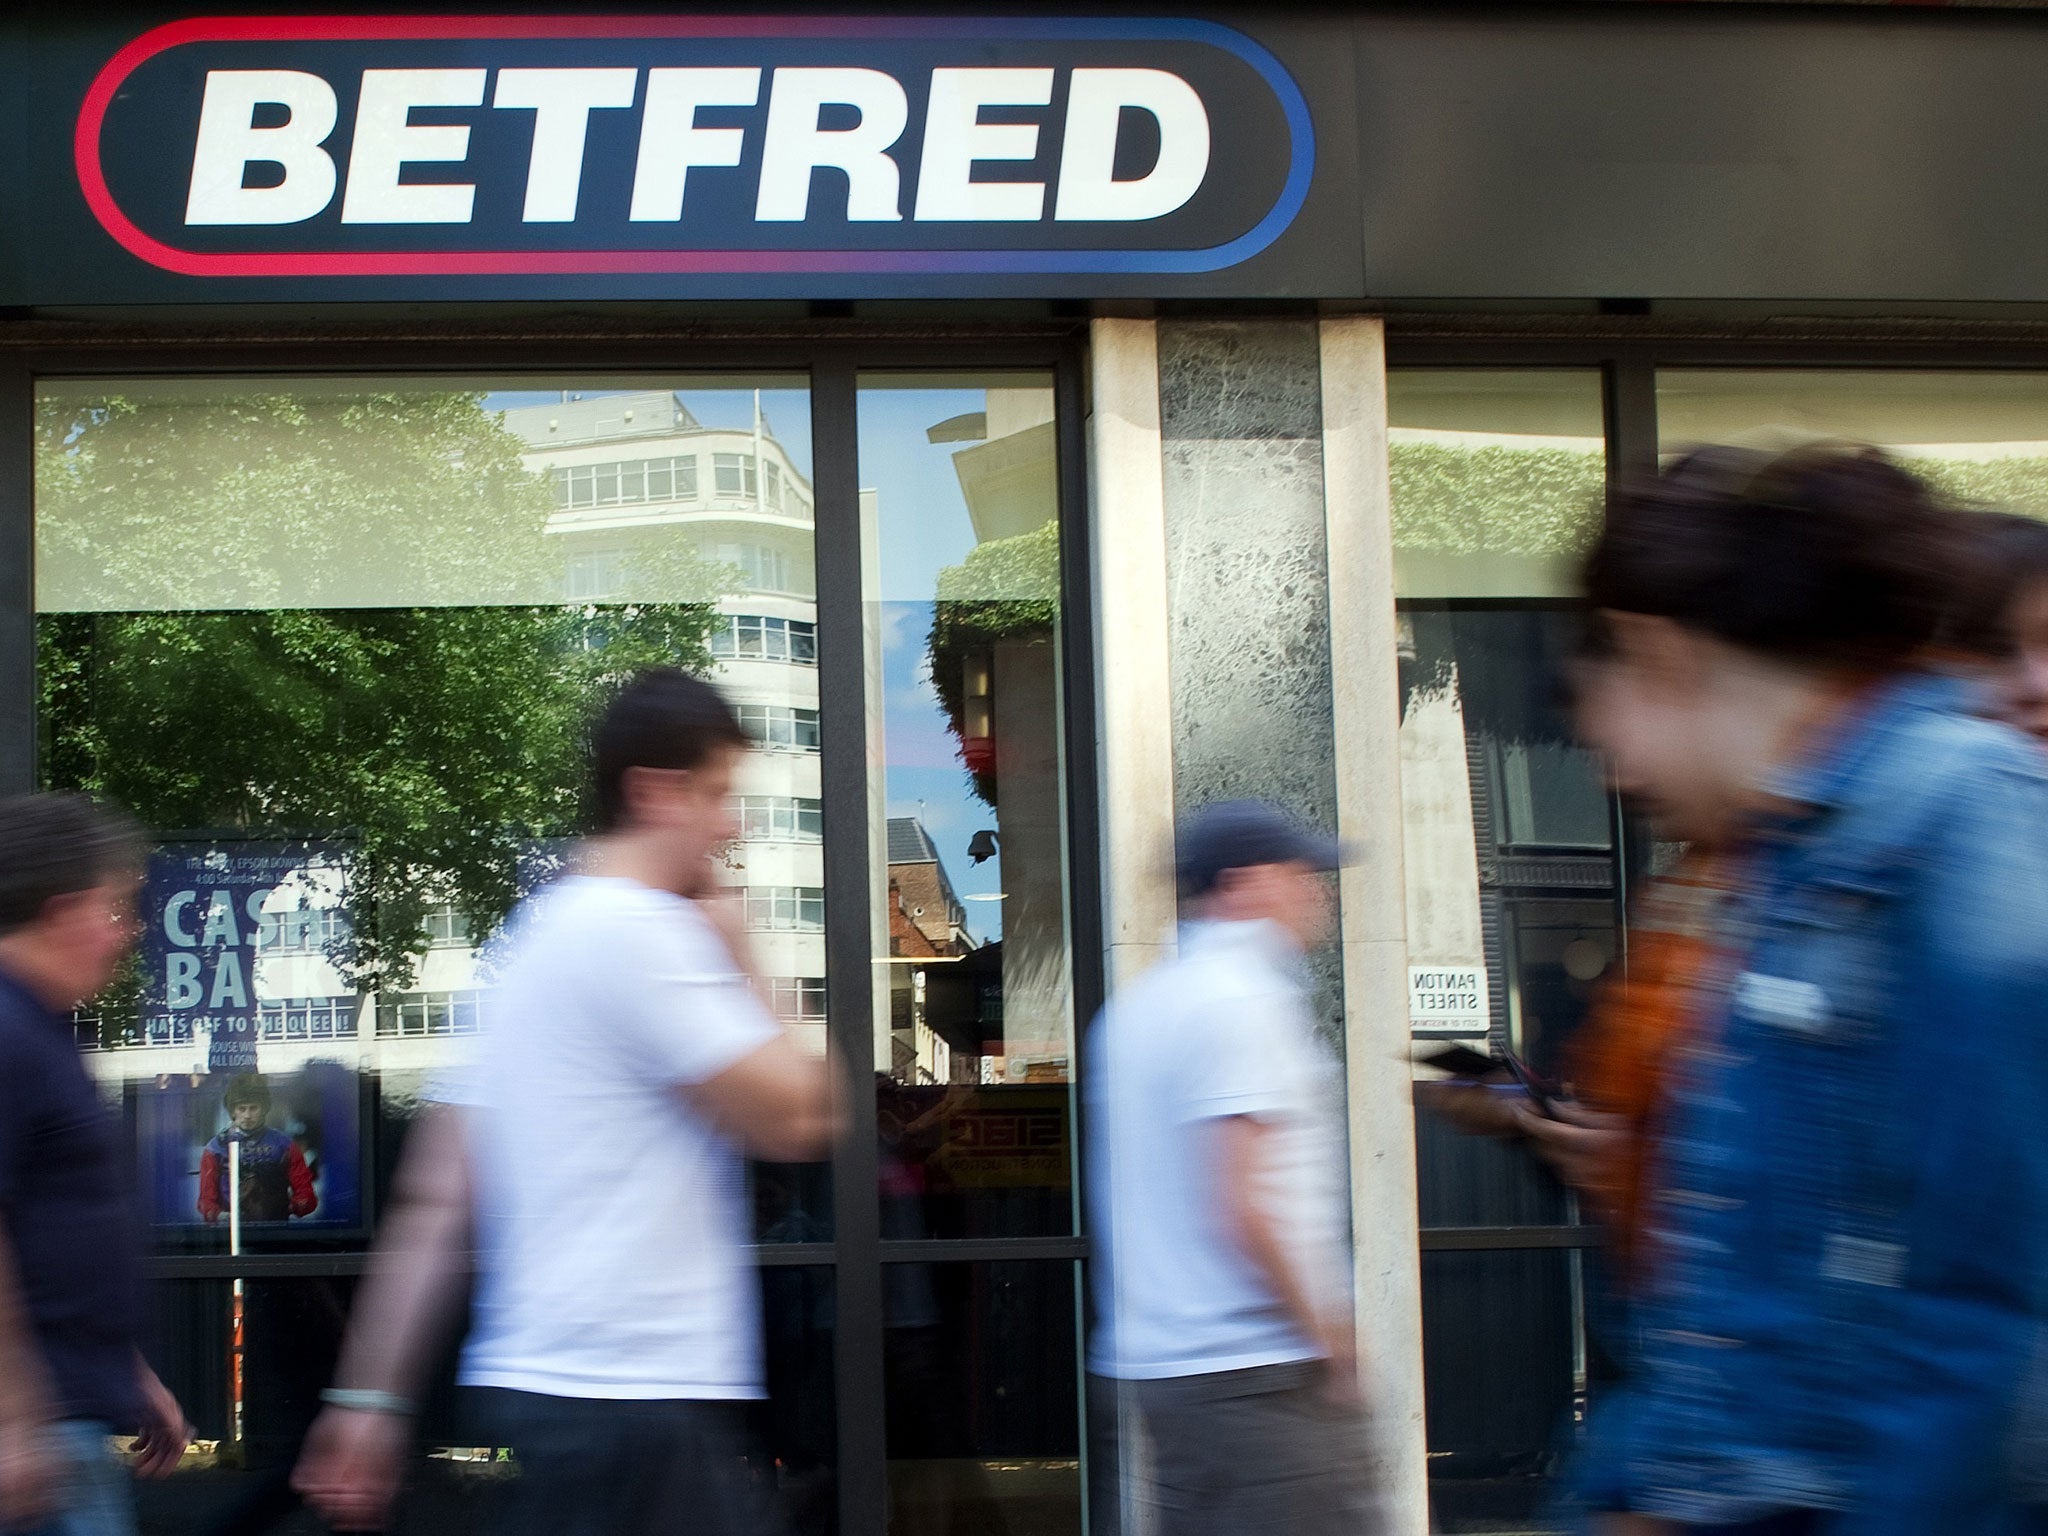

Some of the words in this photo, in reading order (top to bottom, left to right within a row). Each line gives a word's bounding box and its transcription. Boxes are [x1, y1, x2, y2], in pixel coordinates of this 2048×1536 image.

[184, 67, 1211, 225] BETFRED
[163, 889, 324, 948] CASH
[146, 1016, 188, 1034] HATS
[226, 1016, 247, 1032] TO
[253, 1015, 282, 1032] THE
